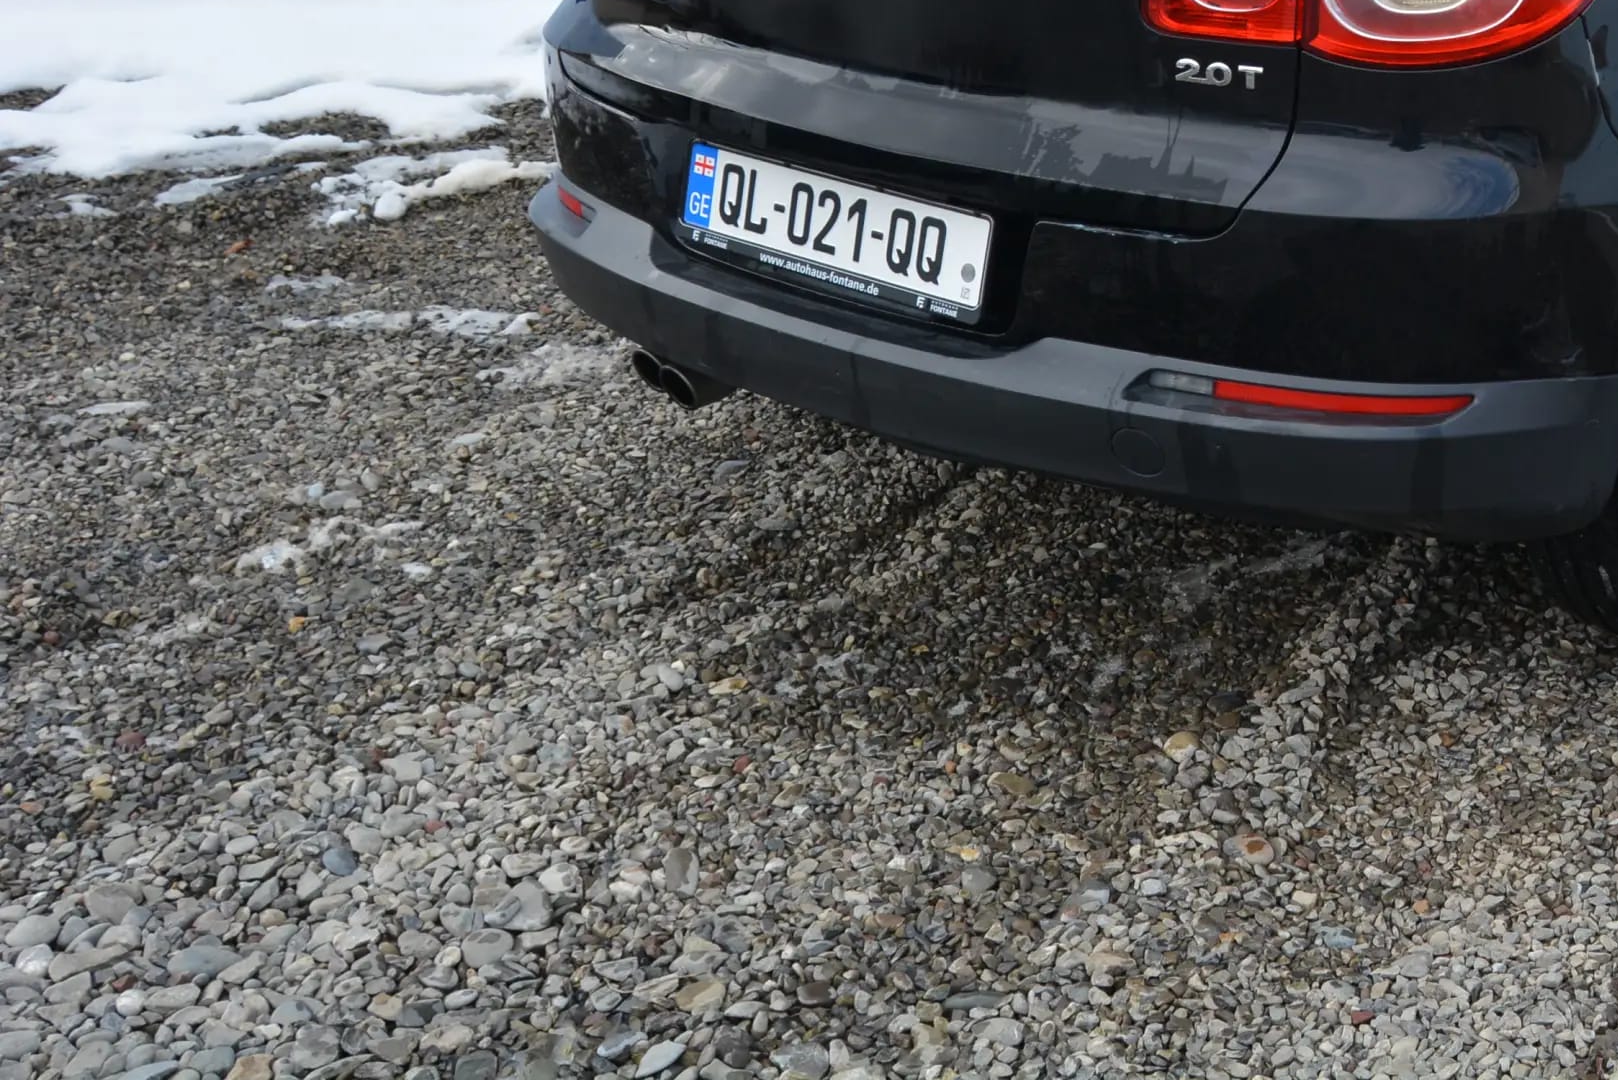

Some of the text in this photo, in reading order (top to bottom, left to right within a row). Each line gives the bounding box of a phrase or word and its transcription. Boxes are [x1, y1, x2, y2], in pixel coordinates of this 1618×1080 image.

[689, 191, 711, 218] GE
[718, 163, 947, 286] QL-021-QQ
[760, 252, 879, 296] www.autohaus-fontane.de
